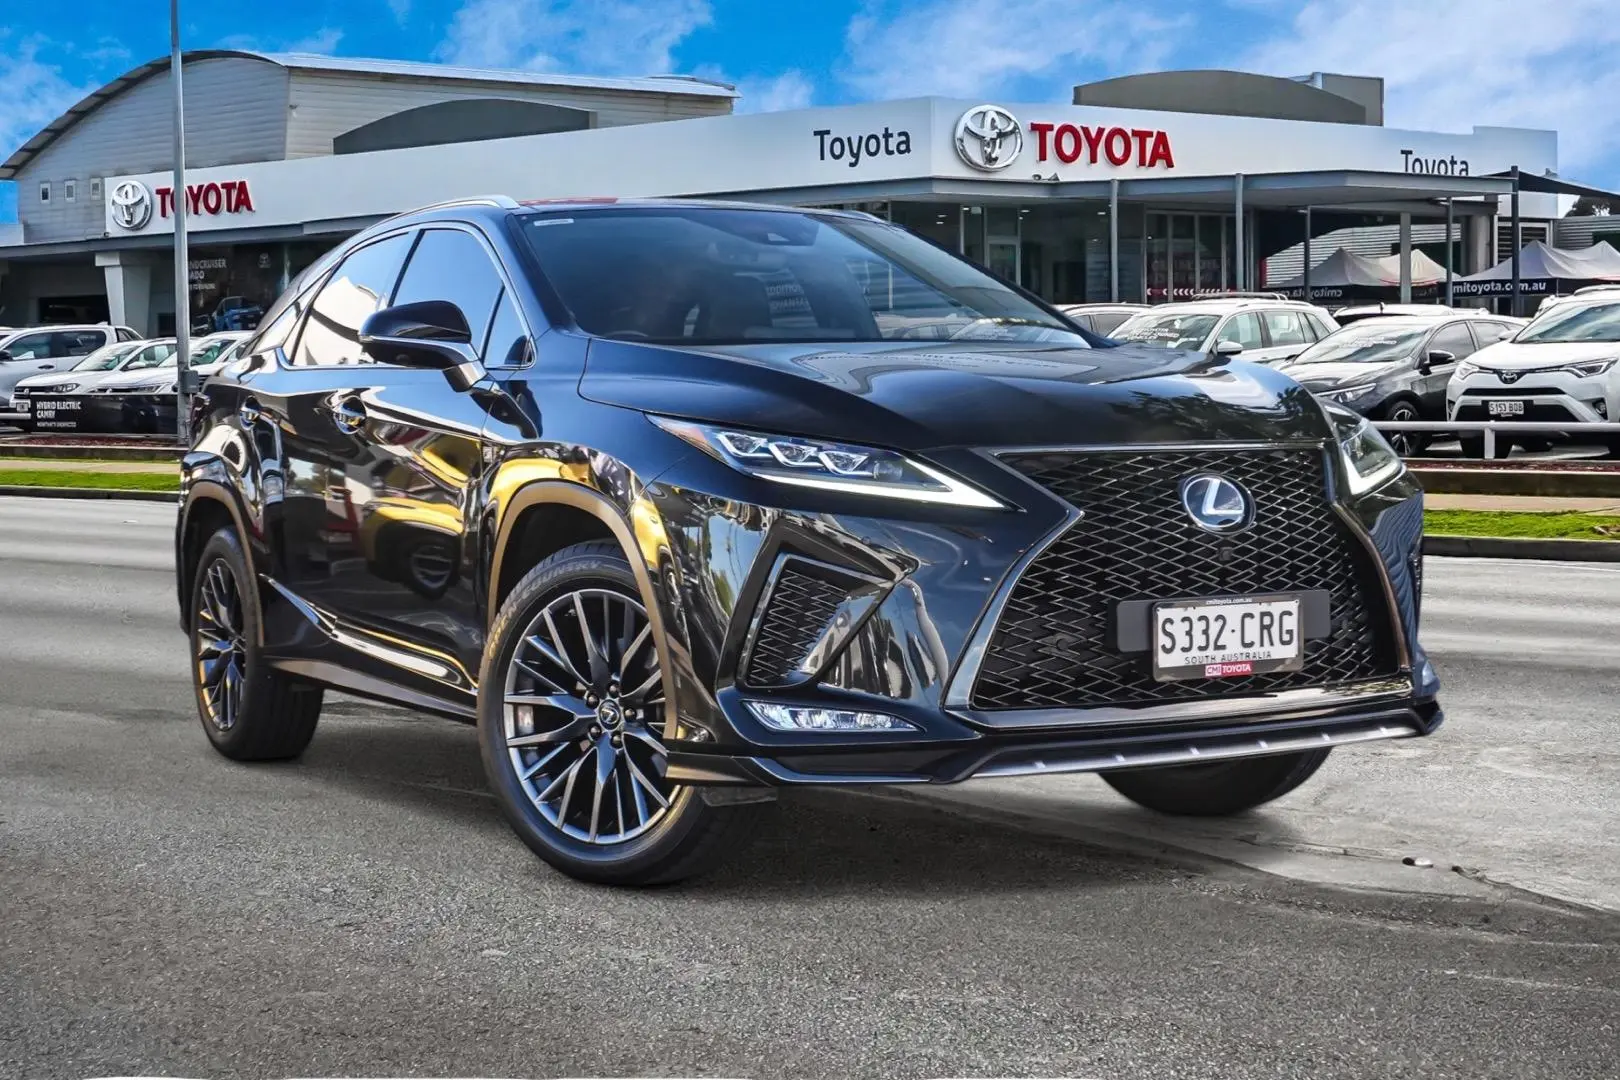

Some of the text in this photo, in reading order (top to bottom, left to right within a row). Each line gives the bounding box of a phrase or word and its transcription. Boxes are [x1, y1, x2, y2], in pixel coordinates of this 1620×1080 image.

[813, 127, 912, 168] Toyota
[1030, 122, 1175, 168] TOYOTA
[1453, 281, 1546, 295] mitoyota.cm.au
[36, 401, 56, 410] HYBRID
[56, 400, 82, 410] ELECTRIC
[1184, 650, 1272, 665] SOUTH AUSTRALIA
[1222, 664, 1252, 674] TOYOTA
